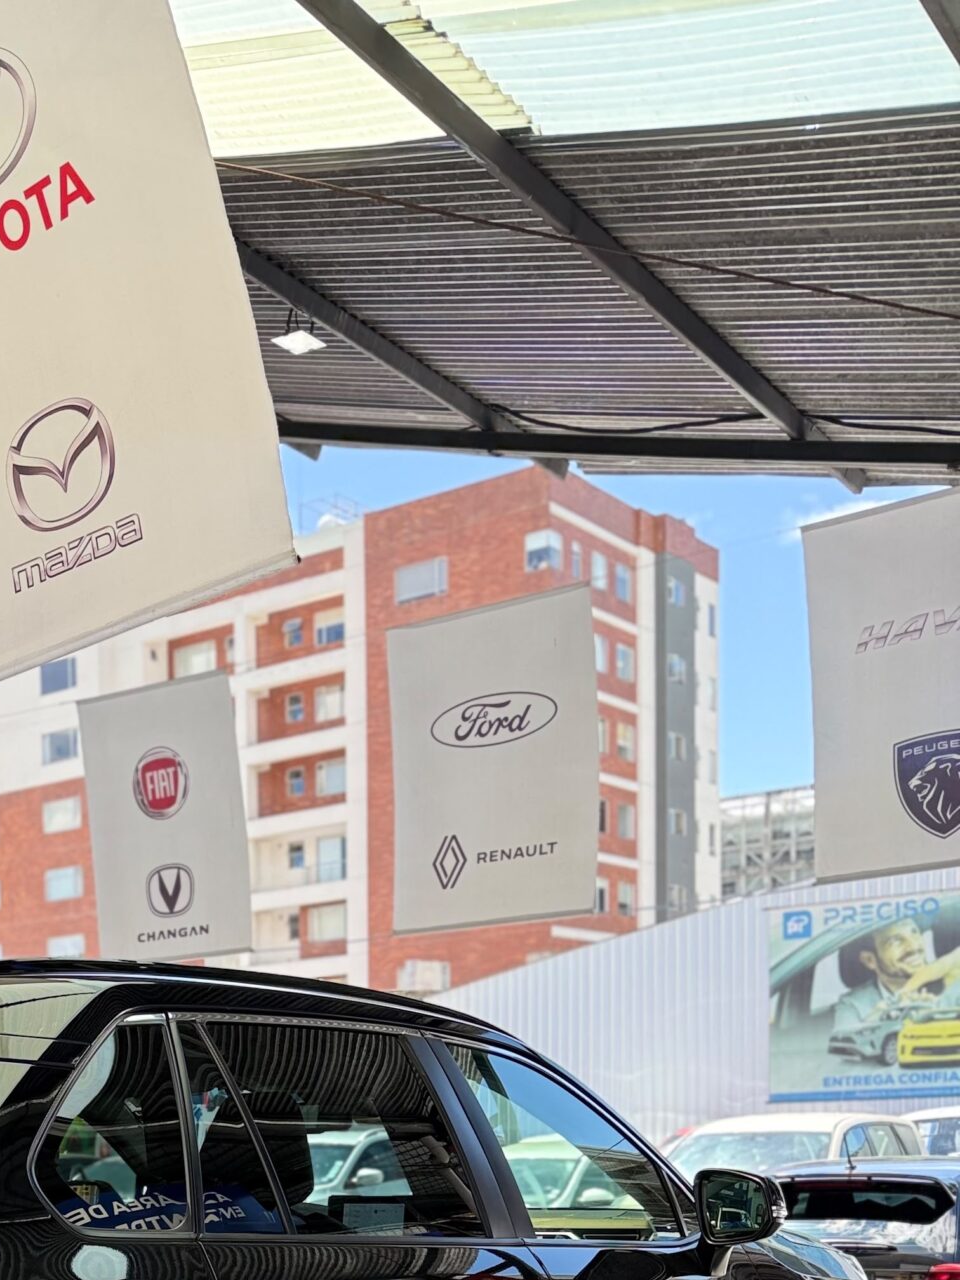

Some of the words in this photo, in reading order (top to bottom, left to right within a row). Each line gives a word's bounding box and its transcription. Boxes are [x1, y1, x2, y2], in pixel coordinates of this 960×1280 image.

[855, 606, 960, 654] HAV
[453, 699, 532, 742] Ford
[144, 767, 176, 801] FIAT
[476, 840, 558, 866] RENAULT
[824, 897, 940, 925] PRECISO
[137, 924, 209, 943] CHANGAN
[823, 1074, 895, 1088] ENTREGA
